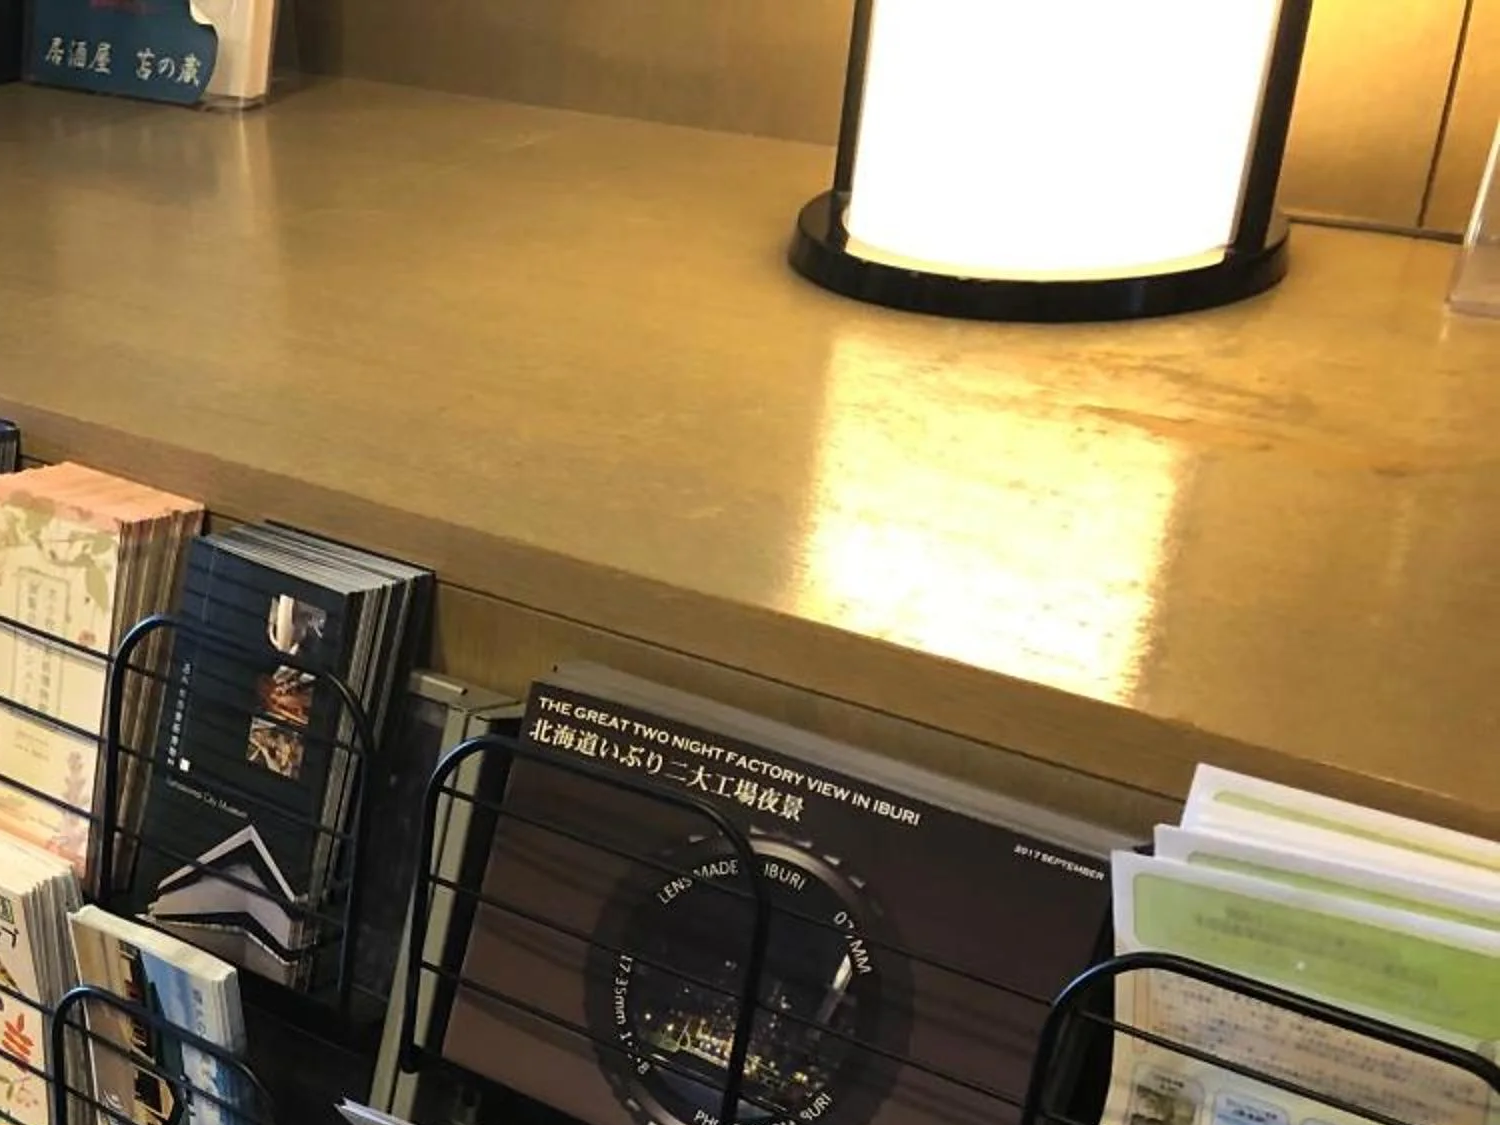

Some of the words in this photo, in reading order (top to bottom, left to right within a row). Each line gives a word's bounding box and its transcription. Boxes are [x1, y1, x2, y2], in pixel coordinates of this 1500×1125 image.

[45, 36, 112, 75] 居酒屋
[529, 717, 804, 822] 北海道いぶり二大工場夜景
[539, 697, 572, 716] THE
[573, 707, 631, 732] GREAT
[633, 722, 670, 745] TWO
[671, 735, 725, 761] NIGHT
[725, 751, 805, 785] FACTORY
[806, 777, 851, 802] VIEW
[851, 792, 871, 810] IN
[873, 799, 921, 827] IBURI
[656, 876, 694, 905] LENS
[693, 858, 740, 880] MADE
[763, 862, 807, 892] IBURI
[1013, 844, 1041, 860] 2017
[1041, 853, 1105, 881] SEPTEMBER
